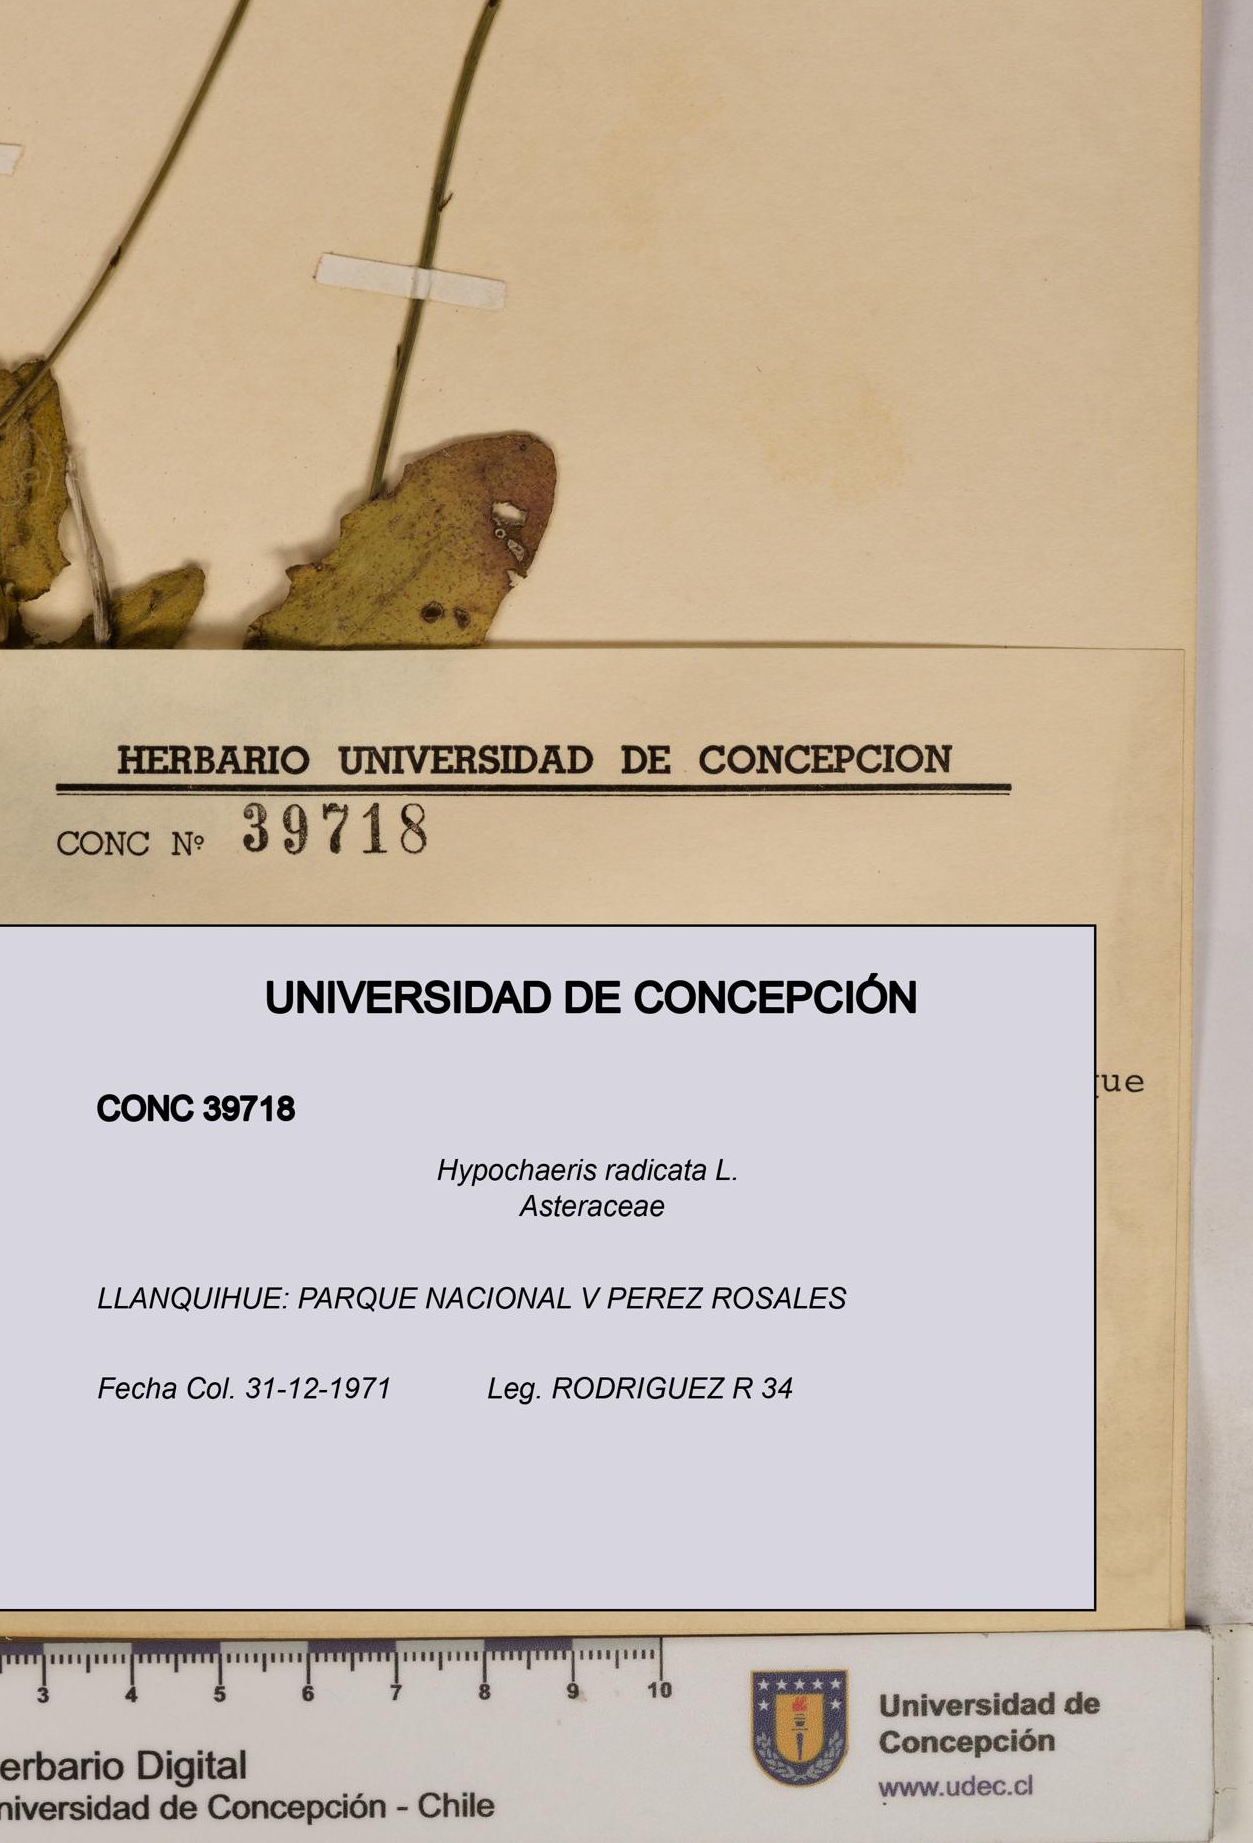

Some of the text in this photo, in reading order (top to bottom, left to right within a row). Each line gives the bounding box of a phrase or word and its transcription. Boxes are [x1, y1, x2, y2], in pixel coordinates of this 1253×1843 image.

[117, 743, 953, 776] HERBARIO UNIVERSIDAD DE CONCEPCION
[56, 830, 150, 857] CONC
[242, 802, 428, 856] 39718
[1095, 1073, 1145, 1099] ue
[36, 1685, 50, 1704] 3
[124, 1685, 139, 1704] 4
[213, 1684, 227, 1703] 5
[301, 1684, 315, 1703] 6
[389, 1682, 403, 1701] 7
[478, 1682, 492, 1701] 8
[566, 1681, 580, 1700] 9
[647, 1680, 673, 1699] 10
[879, 1691, 1101, 1718] Universidad de
[878, 1727, 1056, 1759] Concepción
[137, 1749, 247, 1789] Digital
[878, 1774, 1033, 1798] www.udec.cl
[159, 1793, 198, 1821] de
[207, 1792, 387, 1826] Concepción
[417, 1791, 496, 1819] Chile
